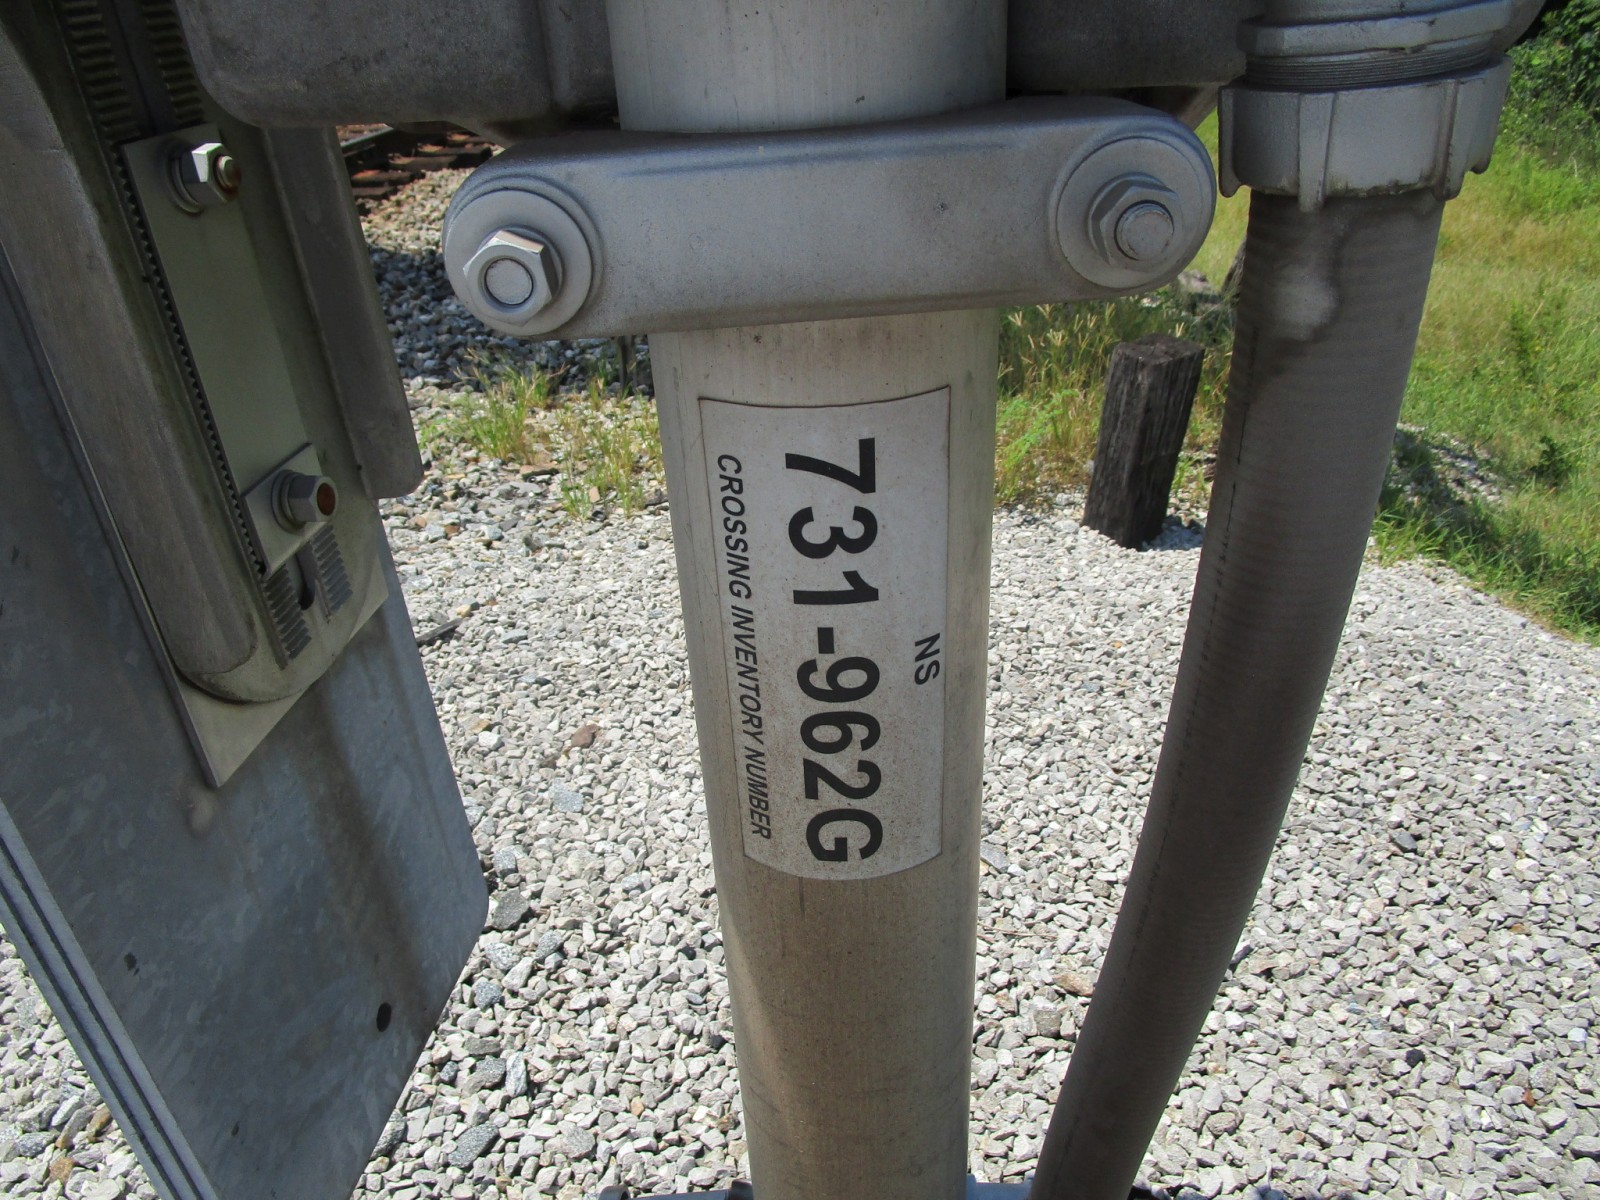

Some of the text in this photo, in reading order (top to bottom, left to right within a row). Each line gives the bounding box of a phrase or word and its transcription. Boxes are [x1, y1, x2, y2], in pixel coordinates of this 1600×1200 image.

[717, 453, 771, 840] CROSSING INVENTORY NUMBER
[785, 437, 884, 862] 731-962G
[913, 632, 940, 686] NS
